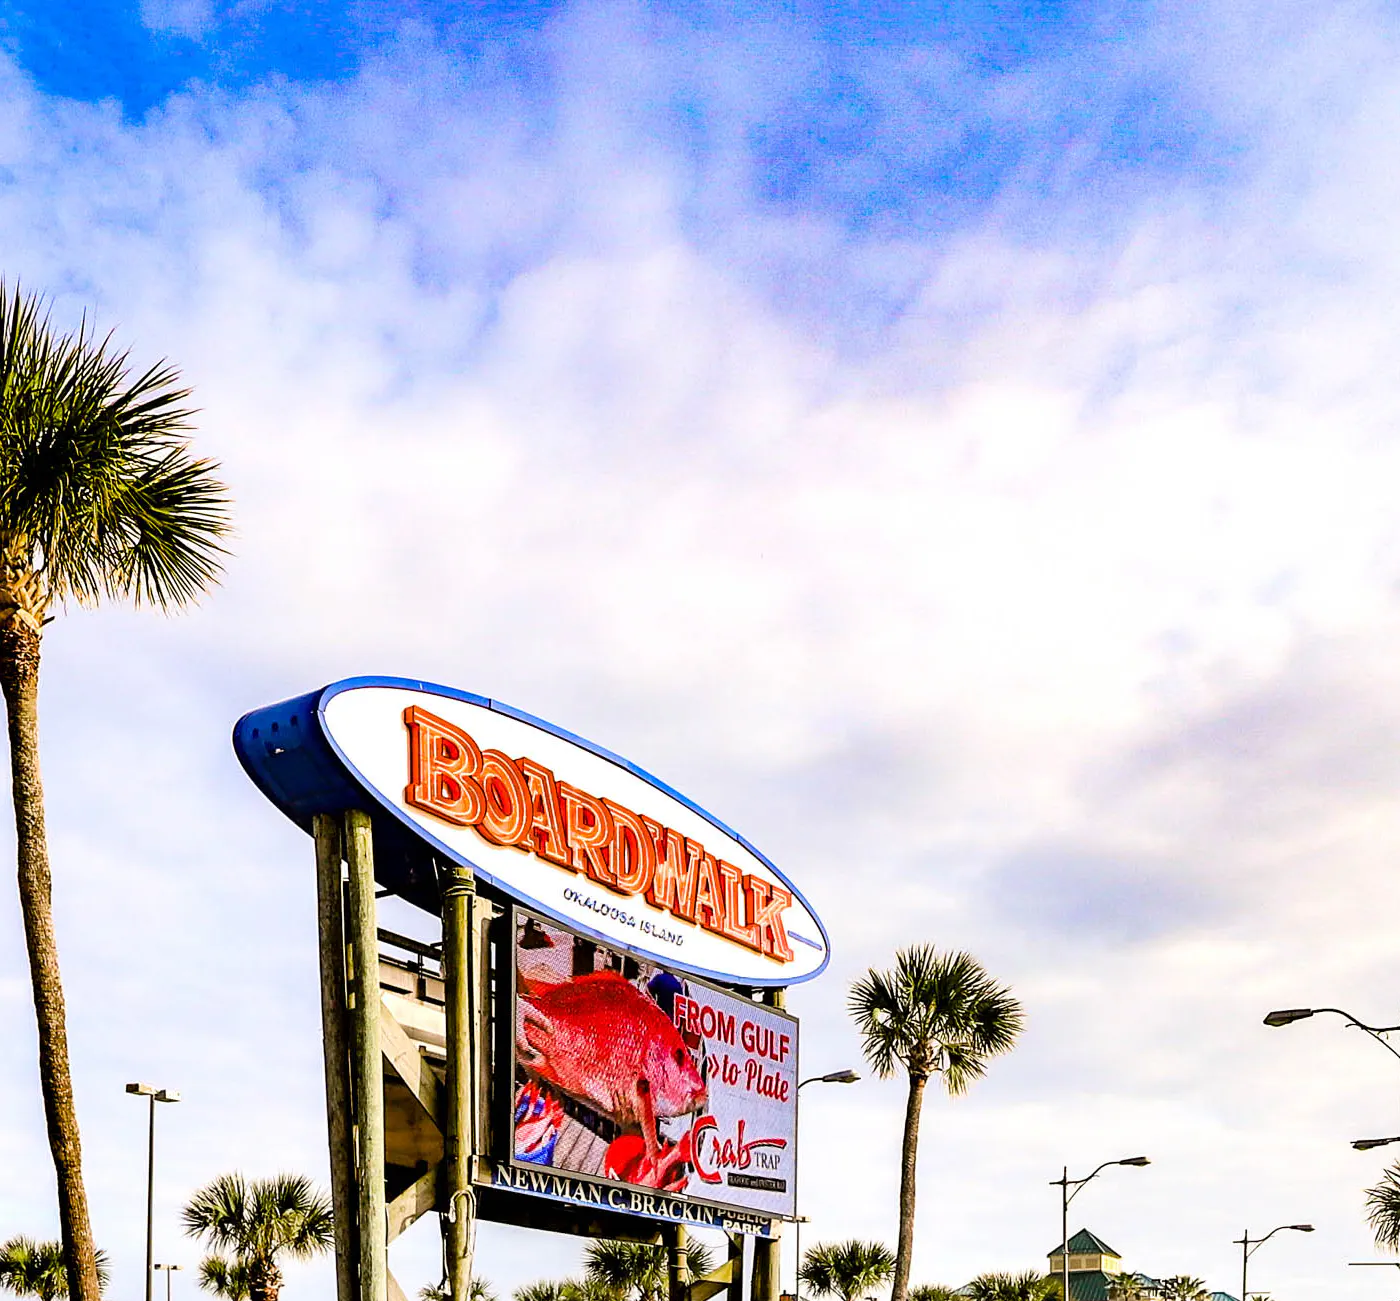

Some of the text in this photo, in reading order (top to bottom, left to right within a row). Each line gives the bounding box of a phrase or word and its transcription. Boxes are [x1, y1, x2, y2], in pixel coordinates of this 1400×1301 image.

[401, 704, 795, 964] BOARDWALK
[563, 887, 684, 947] OKALOOSA ISLAND
[673, 992, 791, 1064] FROM GULF
[721, 1053, 790, 1103] to Plate
[690, 1114, 788, 1184] Crab TRAP
[496, 1164, 604, 1205] NEWMAN
[629, 1192, 716, 1225] BRACKIN
[722, 1218, 764, 1236] PARK
